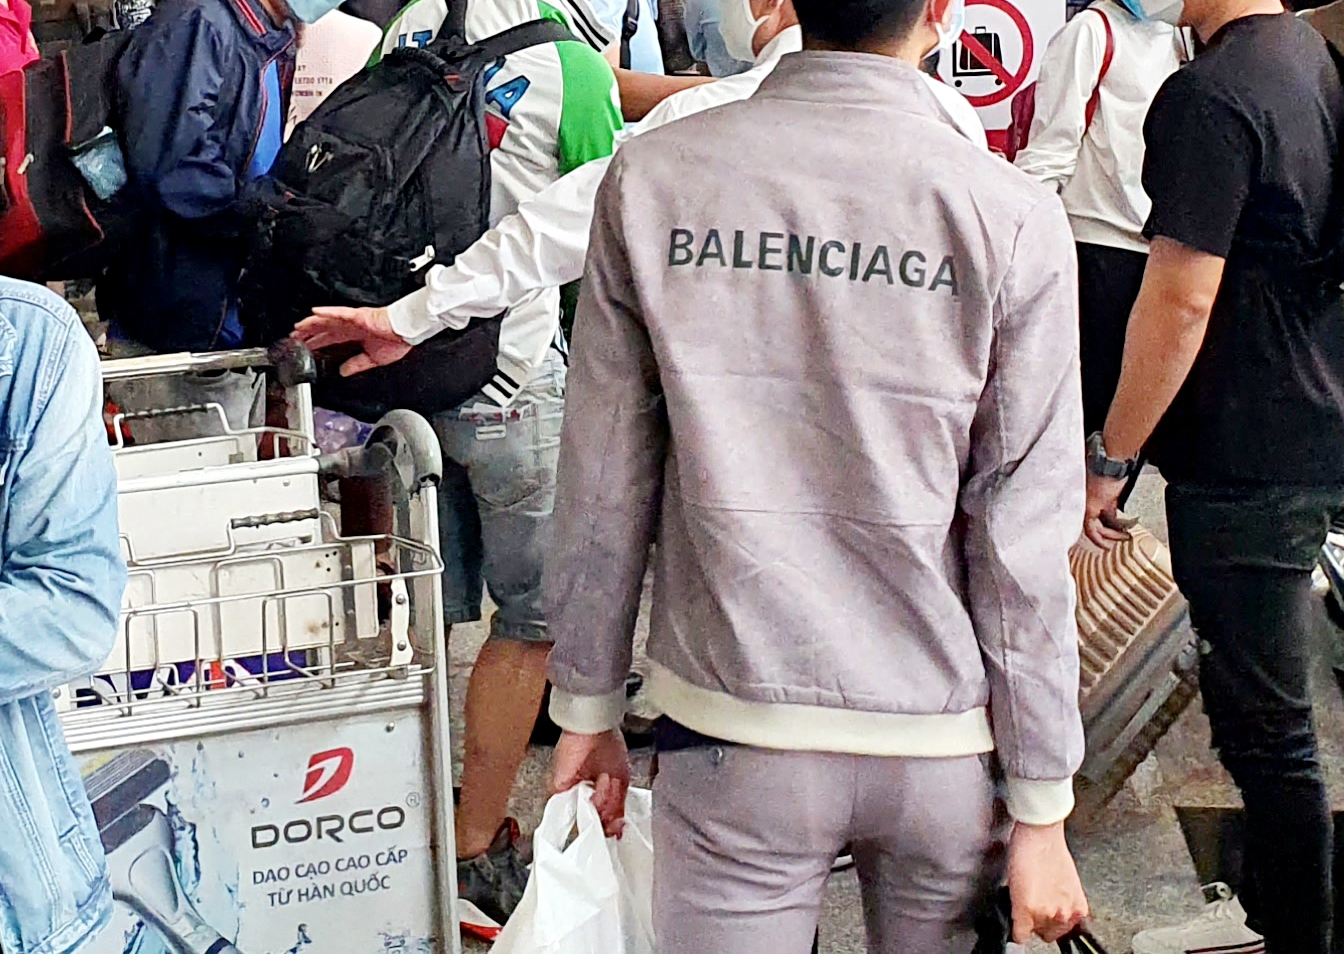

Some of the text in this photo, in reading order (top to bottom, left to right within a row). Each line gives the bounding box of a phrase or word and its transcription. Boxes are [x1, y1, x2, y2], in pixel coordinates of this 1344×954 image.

[667, 227, 957, 296] BALENCIAGA
[250, 805, 406, 849] DORCO
[252, 844, 409, 885] DAO CẠO CAO CẤP
[267, 871, 391, 907] TỪ HÀN QUỐC
